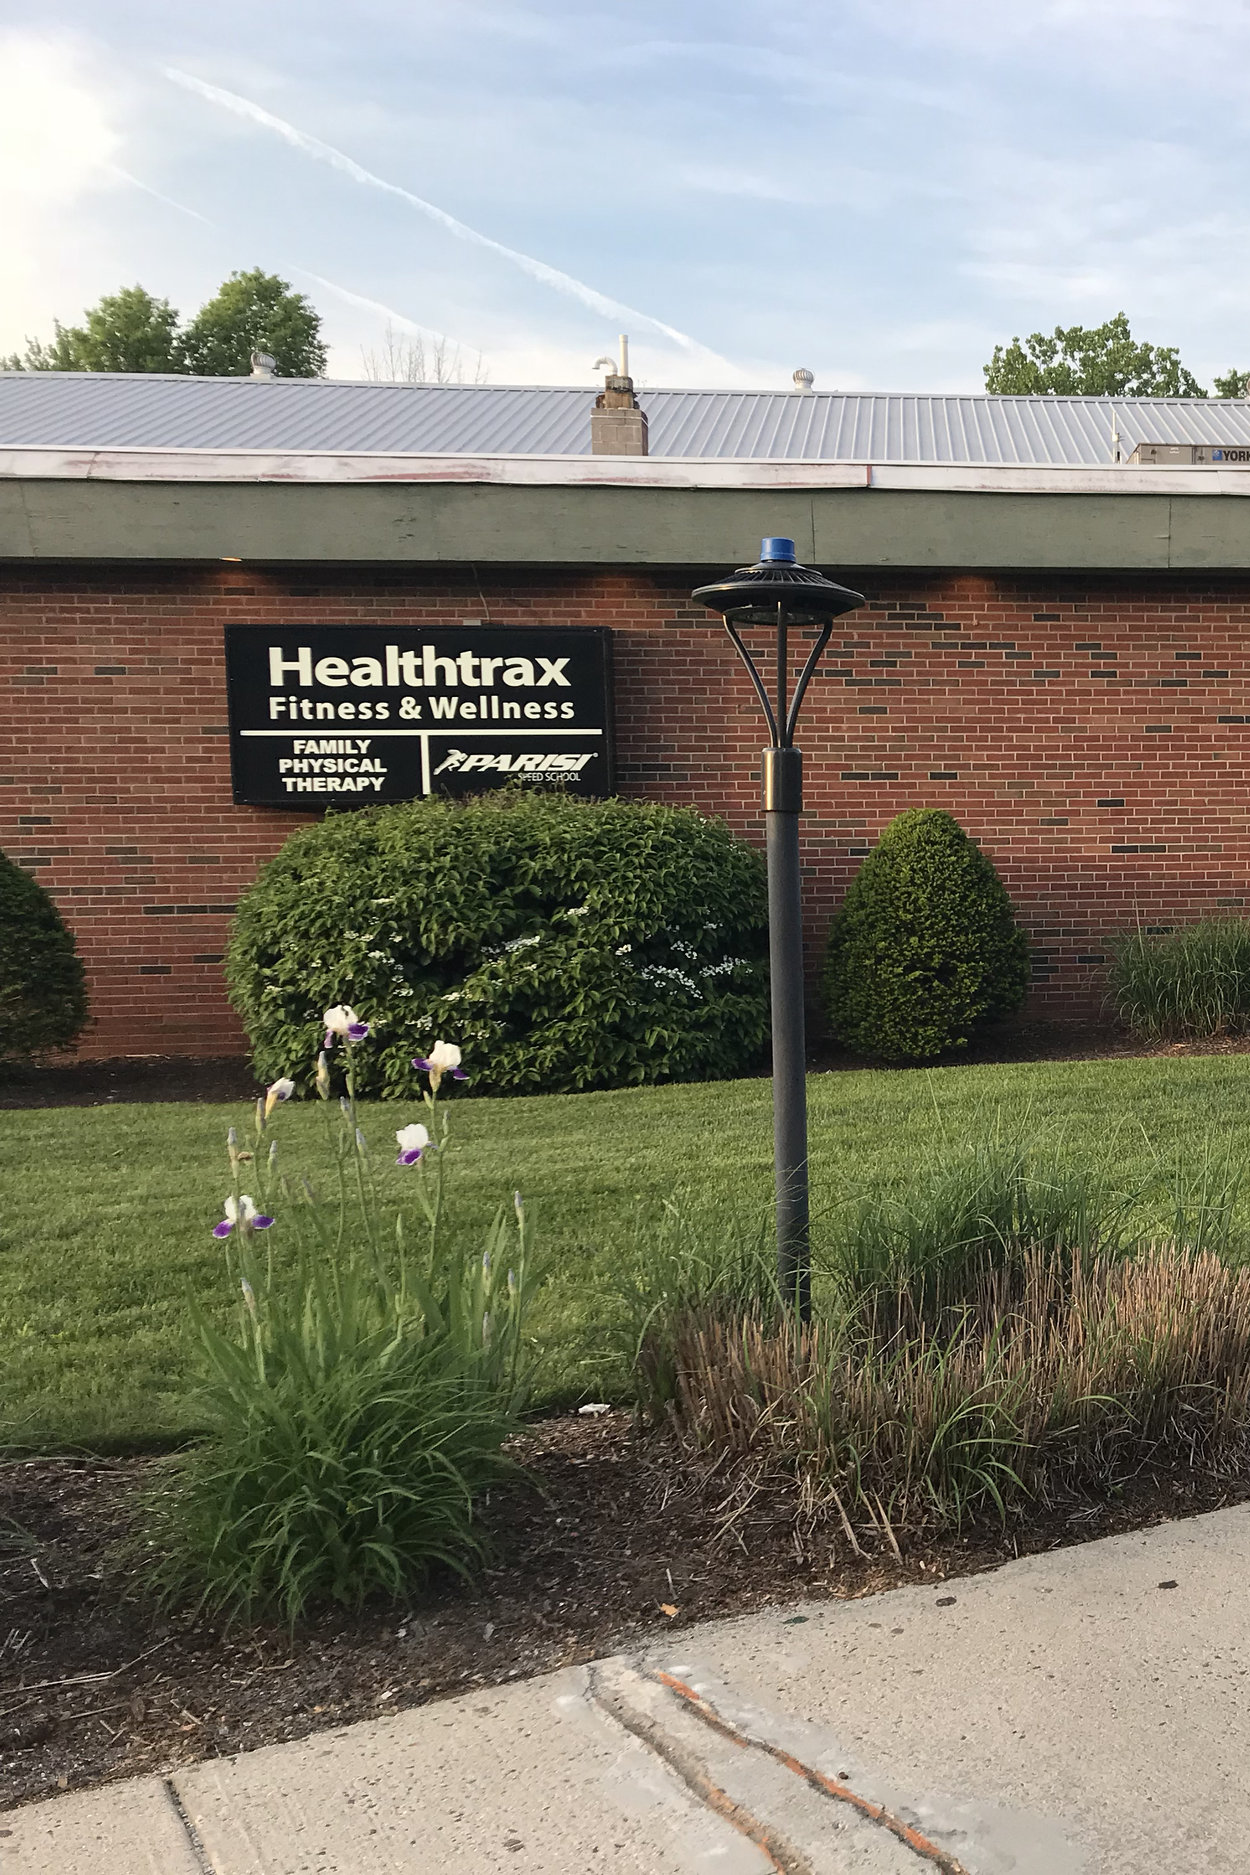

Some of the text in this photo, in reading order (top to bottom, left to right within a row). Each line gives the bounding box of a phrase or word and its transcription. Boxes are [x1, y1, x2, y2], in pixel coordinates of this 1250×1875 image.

[269, 645, 572, 687] Healthtrax
[269, 695, 575, 720] Fitness & Wellness
[293, 739, 372, 755] FAMILY
[279, 758, 388, 774] PHYSICAL
[458, 754, 593, 772] PARISI
[281, 776, 386, 792] THERAPY
[545, 772, 581, 782] SCHOOL
